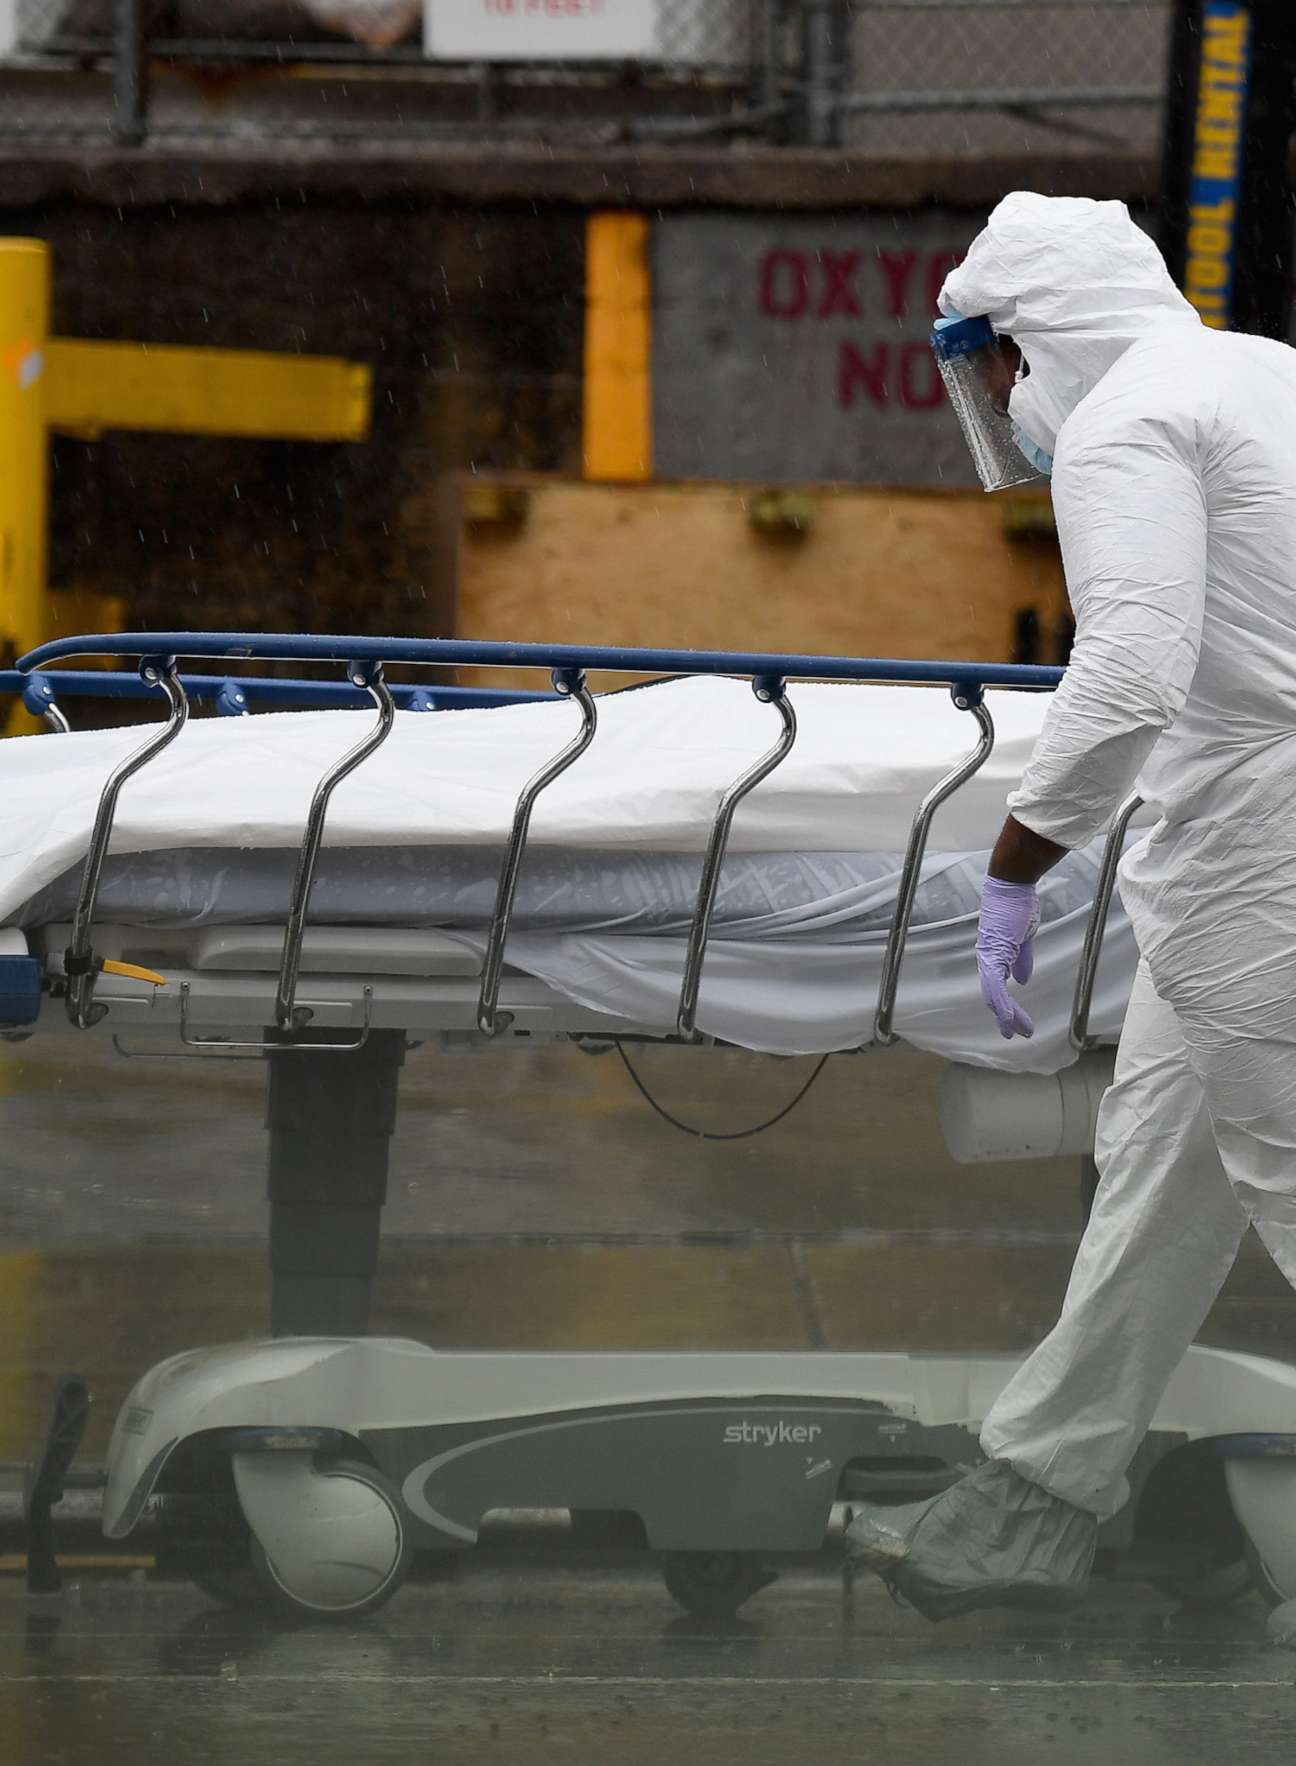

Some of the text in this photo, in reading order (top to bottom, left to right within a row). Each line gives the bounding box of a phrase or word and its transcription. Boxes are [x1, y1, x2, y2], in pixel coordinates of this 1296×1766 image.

[1193, 9, 1248, 178] RENTAL
[837, 340, 946, 410] NO
[723, 1420, 822, 1447] stryker
